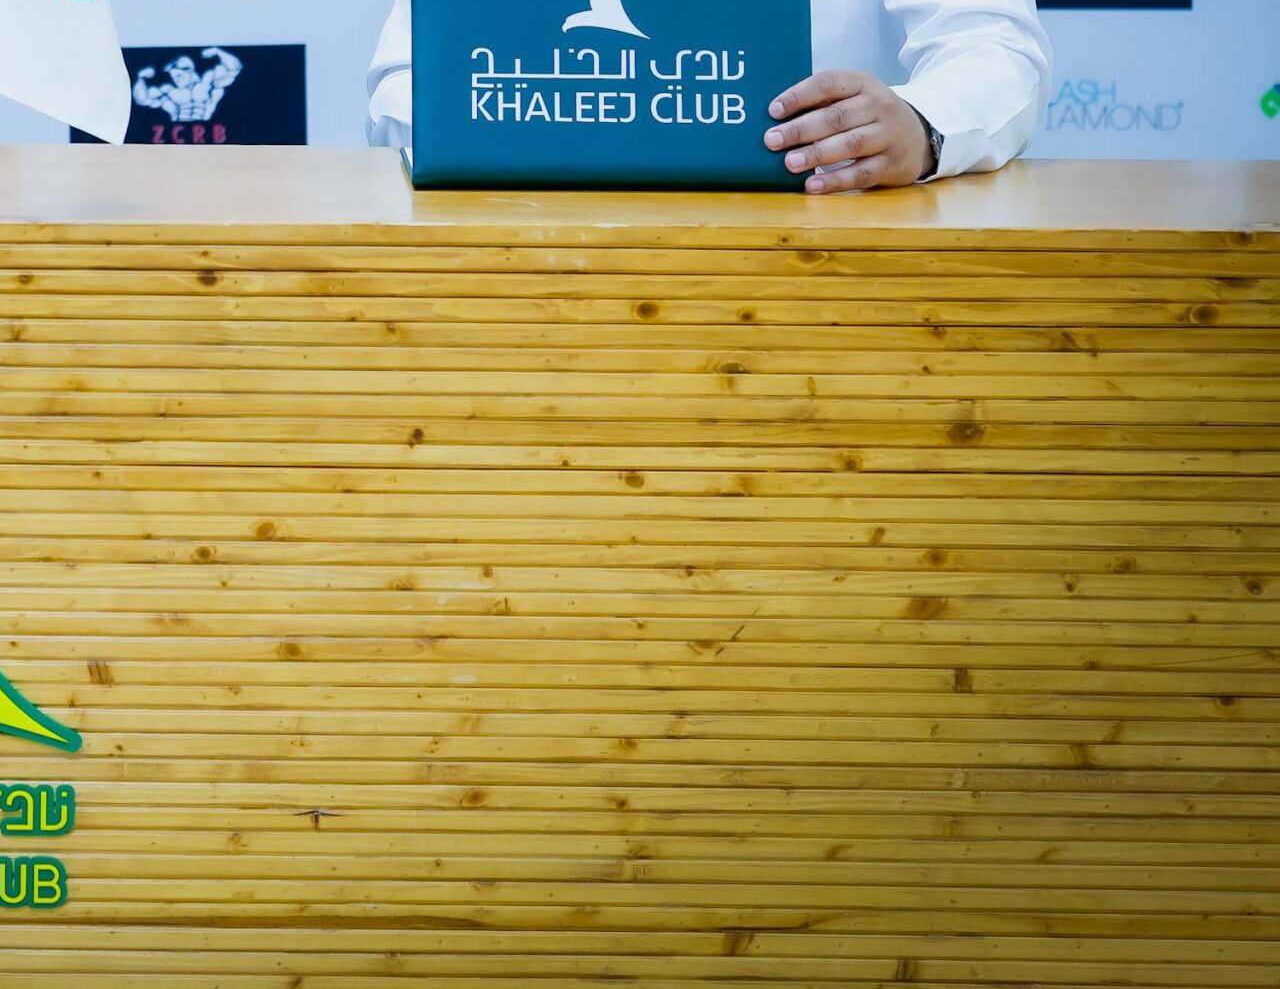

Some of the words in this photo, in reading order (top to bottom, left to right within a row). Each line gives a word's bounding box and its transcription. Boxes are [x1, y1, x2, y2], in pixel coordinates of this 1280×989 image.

[471, 47, 637, 88] الخليج
[649, 49, 746, 91] نادي
[471, 90, 637, 122] KHALEEJ
[650, 91, 747, 124] CLUB
